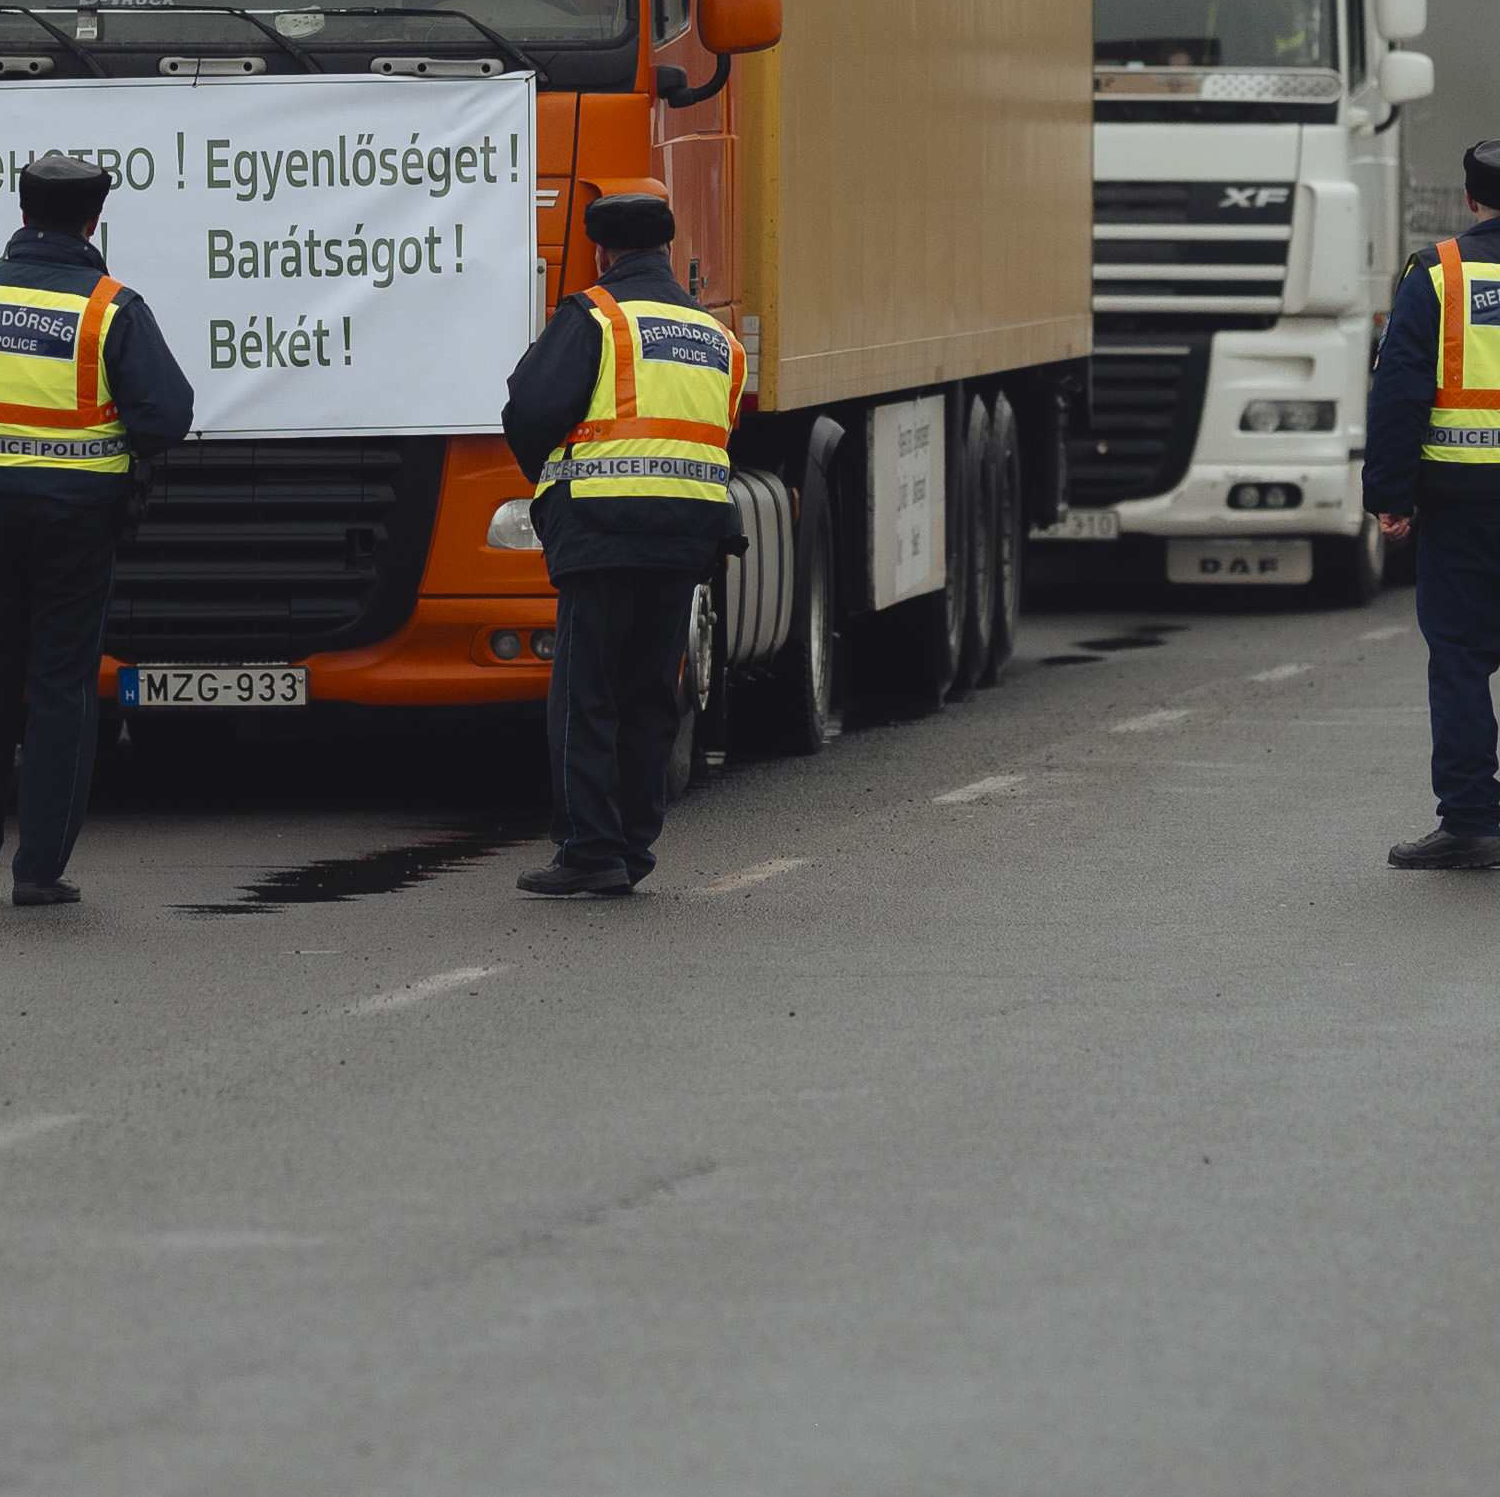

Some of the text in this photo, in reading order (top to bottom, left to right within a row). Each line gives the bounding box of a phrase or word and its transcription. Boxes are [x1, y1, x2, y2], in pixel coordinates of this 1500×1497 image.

[1219, 186, 1290, 208] XF
[672, 346, 708, 363] POLICE
[1428, 429, 1489, 444] POLICE
[649, 461, 703, 478] POLICE
[1199, 557, 1279, 575] DAF
[125, 672, 298, 702] H MZG-933
